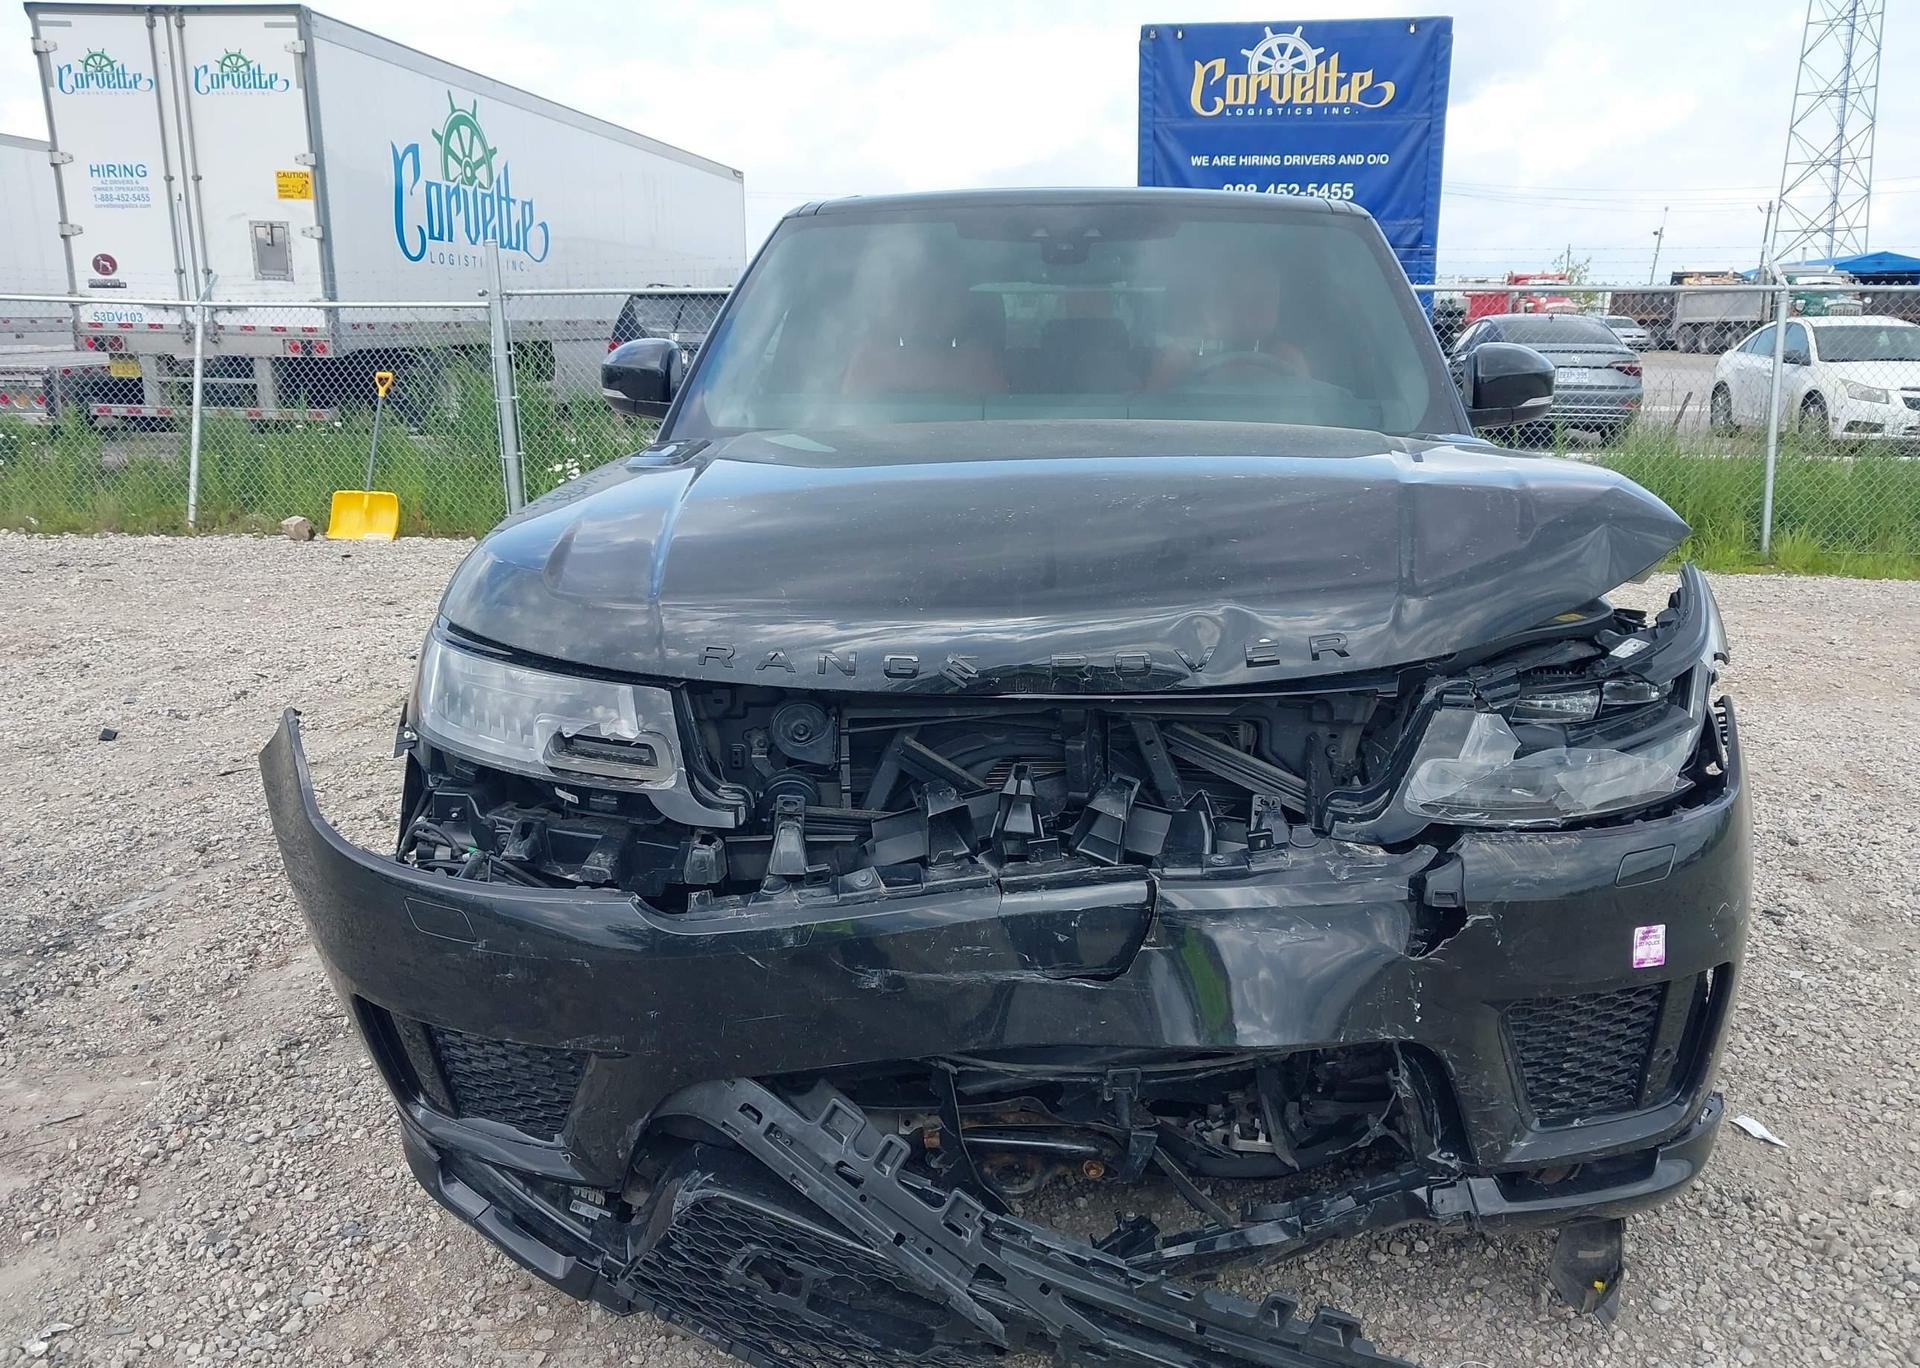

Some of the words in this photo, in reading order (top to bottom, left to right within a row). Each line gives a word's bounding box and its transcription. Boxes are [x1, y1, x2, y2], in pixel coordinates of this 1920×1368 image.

[57, 63, 153, 95] Corvette
[194, 63, 289, 95] Corvette
[1190, 51, 1396, 117] Corvette
[1226, 107, 1313, 116] LOGISTICS
[1324, 106, 1359, 115] INC.
[1190, 155, 1209, 167] WE
[1212, 155, 1236, 166] ARE
[1239, 155, 1281, 166] HIRING
[1284, 154, 1336, 166] DRIVERS
[1338, 154, 1364, 165] AND
[1367, 154, 1389, 165] O/O
[89, 164, 148, 178] HIRING
[276, 171, 309, 179] CAUTION
[1223, 183, 1354, 200] 8452-5455
[391, 140, 549, 262] Corvette
[430, 251, 484, 268] LOGISTI
[93, 311, 143, 322] 53DV103
[698, 643, 979, 689] RANGE
[1051, 632, 1351, 680] ROVER
